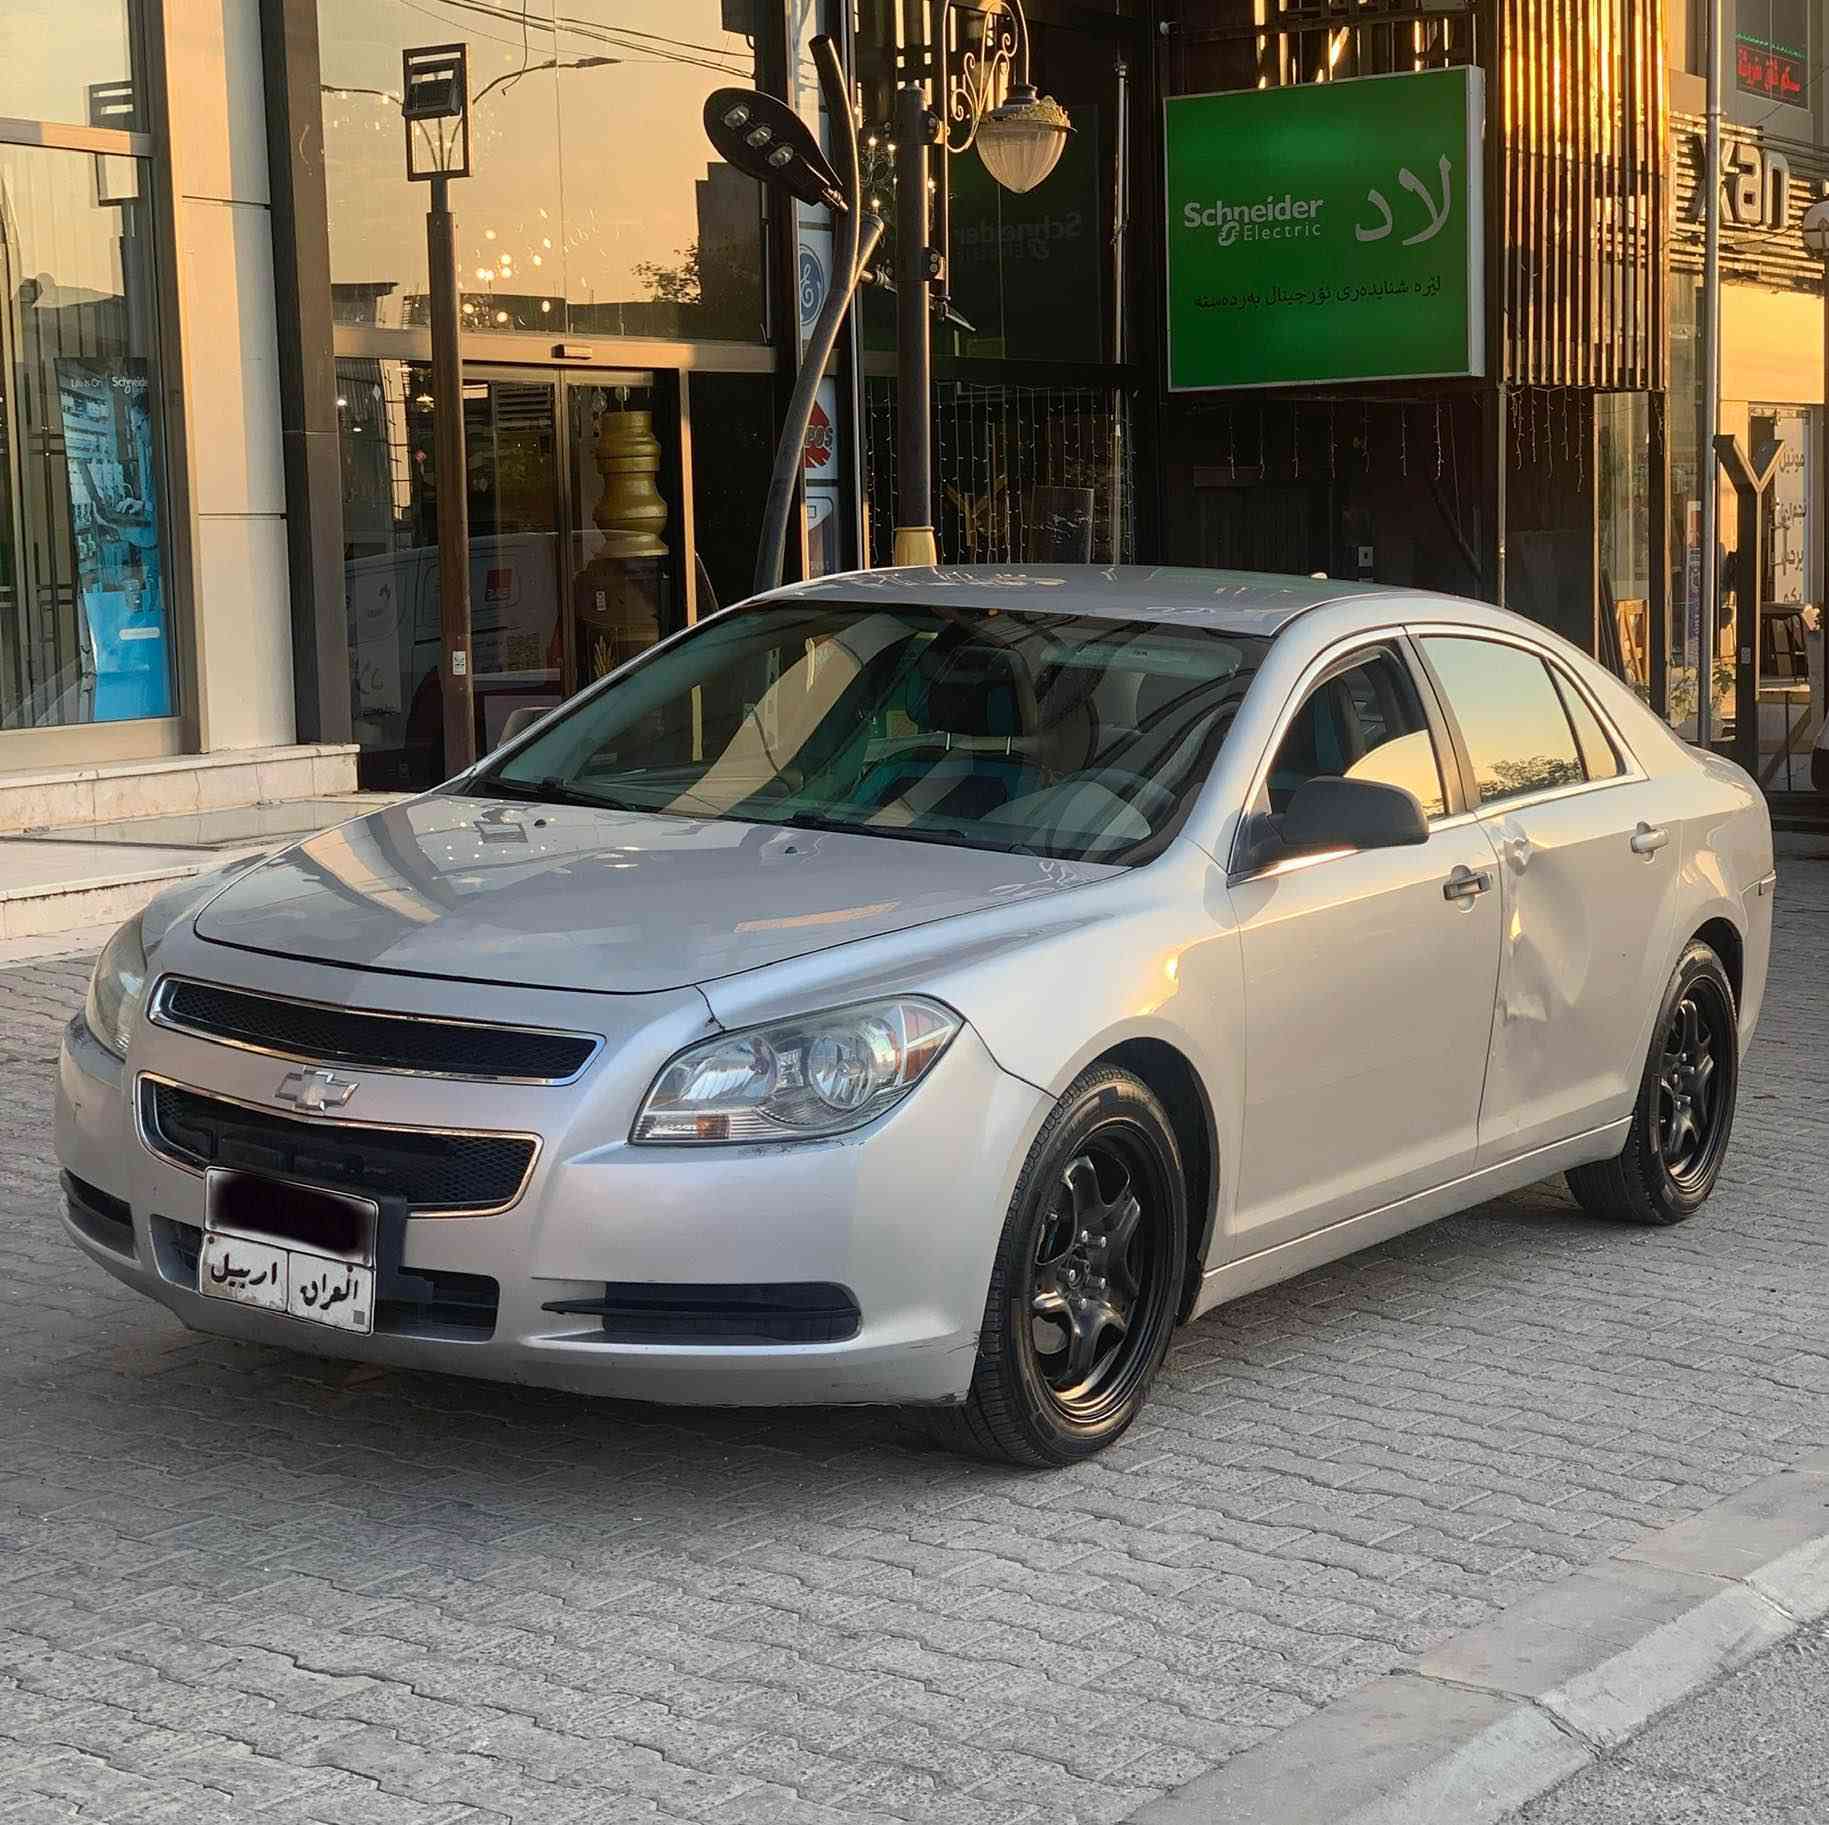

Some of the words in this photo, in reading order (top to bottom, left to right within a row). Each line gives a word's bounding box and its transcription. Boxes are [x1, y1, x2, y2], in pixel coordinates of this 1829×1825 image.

[1184, 195, 1324, 228] Schneider
[1354, 153, 1453, 246] لاد
[1243, 224, 1321, 241] Electric
[210, 1253, 278, 1289] اربيل
